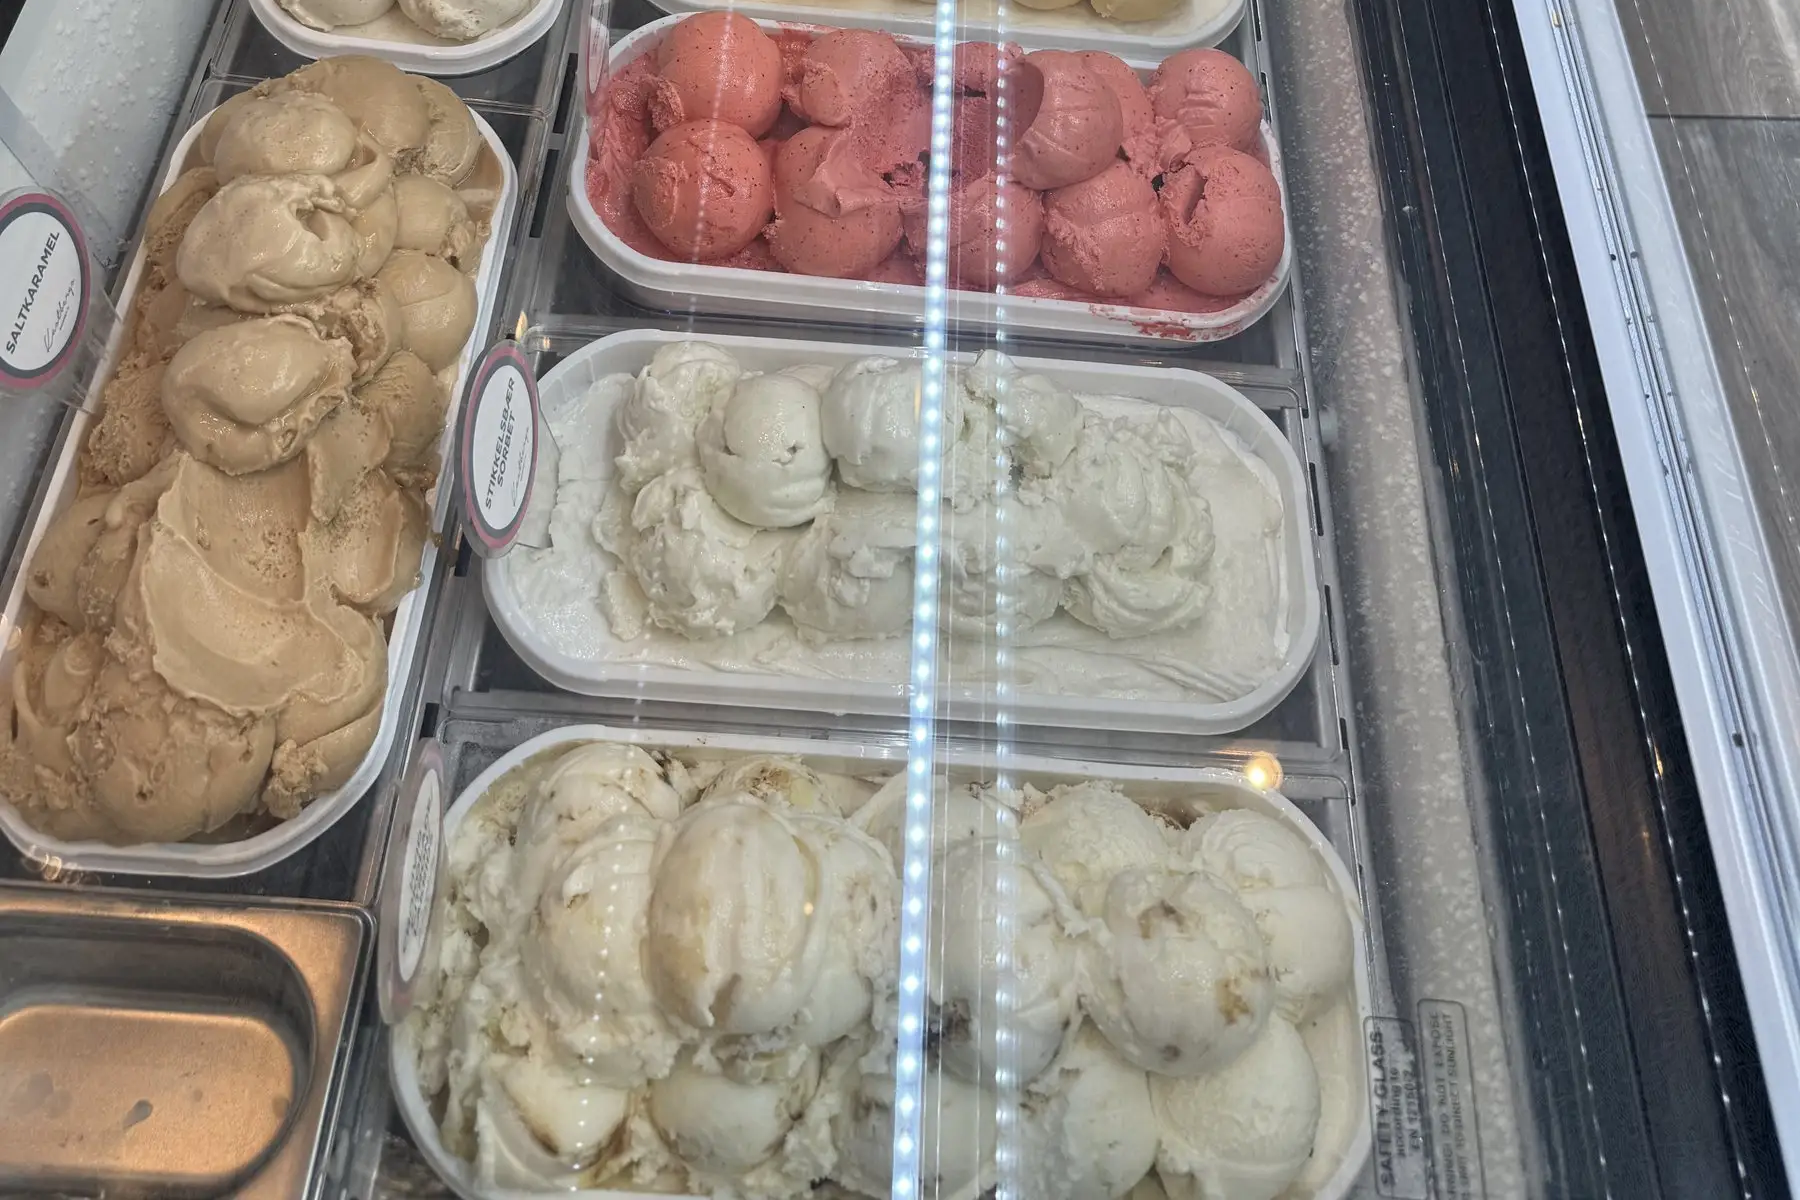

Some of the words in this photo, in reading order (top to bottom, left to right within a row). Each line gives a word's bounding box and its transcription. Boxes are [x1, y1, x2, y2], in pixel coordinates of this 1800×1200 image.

[5, 230, 60, 355] SALTKARAMEL
[485, 376, 516, 510] STIKKELSBÆR
[497, 410, 517, 488] SORBET
[1369, 1030, 1388, 1099] GLASS
